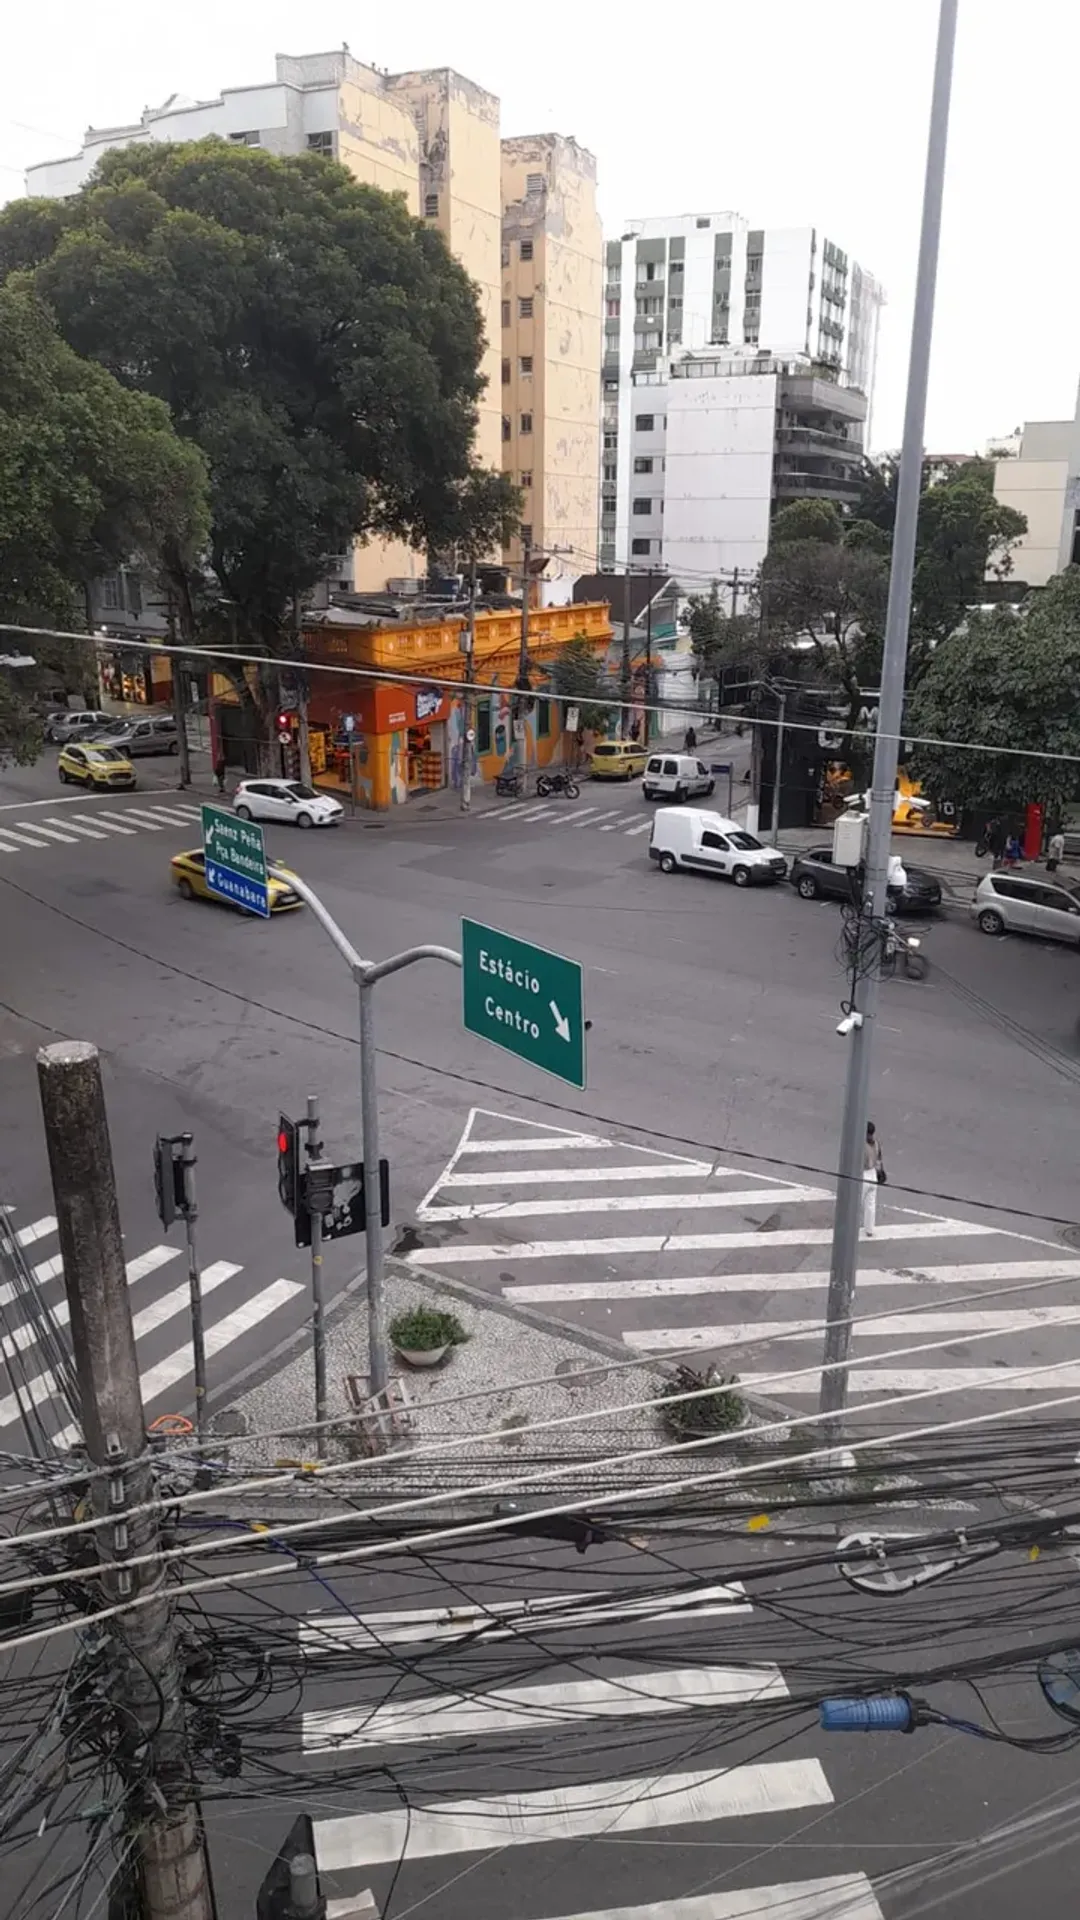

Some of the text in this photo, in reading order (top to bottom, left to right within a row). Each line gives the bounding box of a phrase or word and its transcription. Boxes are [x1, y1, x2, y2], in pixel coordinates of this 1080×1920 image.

[240, 829, 262, 851] Peña
[230, 847, 264, 875] Bandeira
[217, 873, 266, 908] Guanabara
[479, 950, 540, 993] Estácio
[485, 996, 540, 1039] Centro
